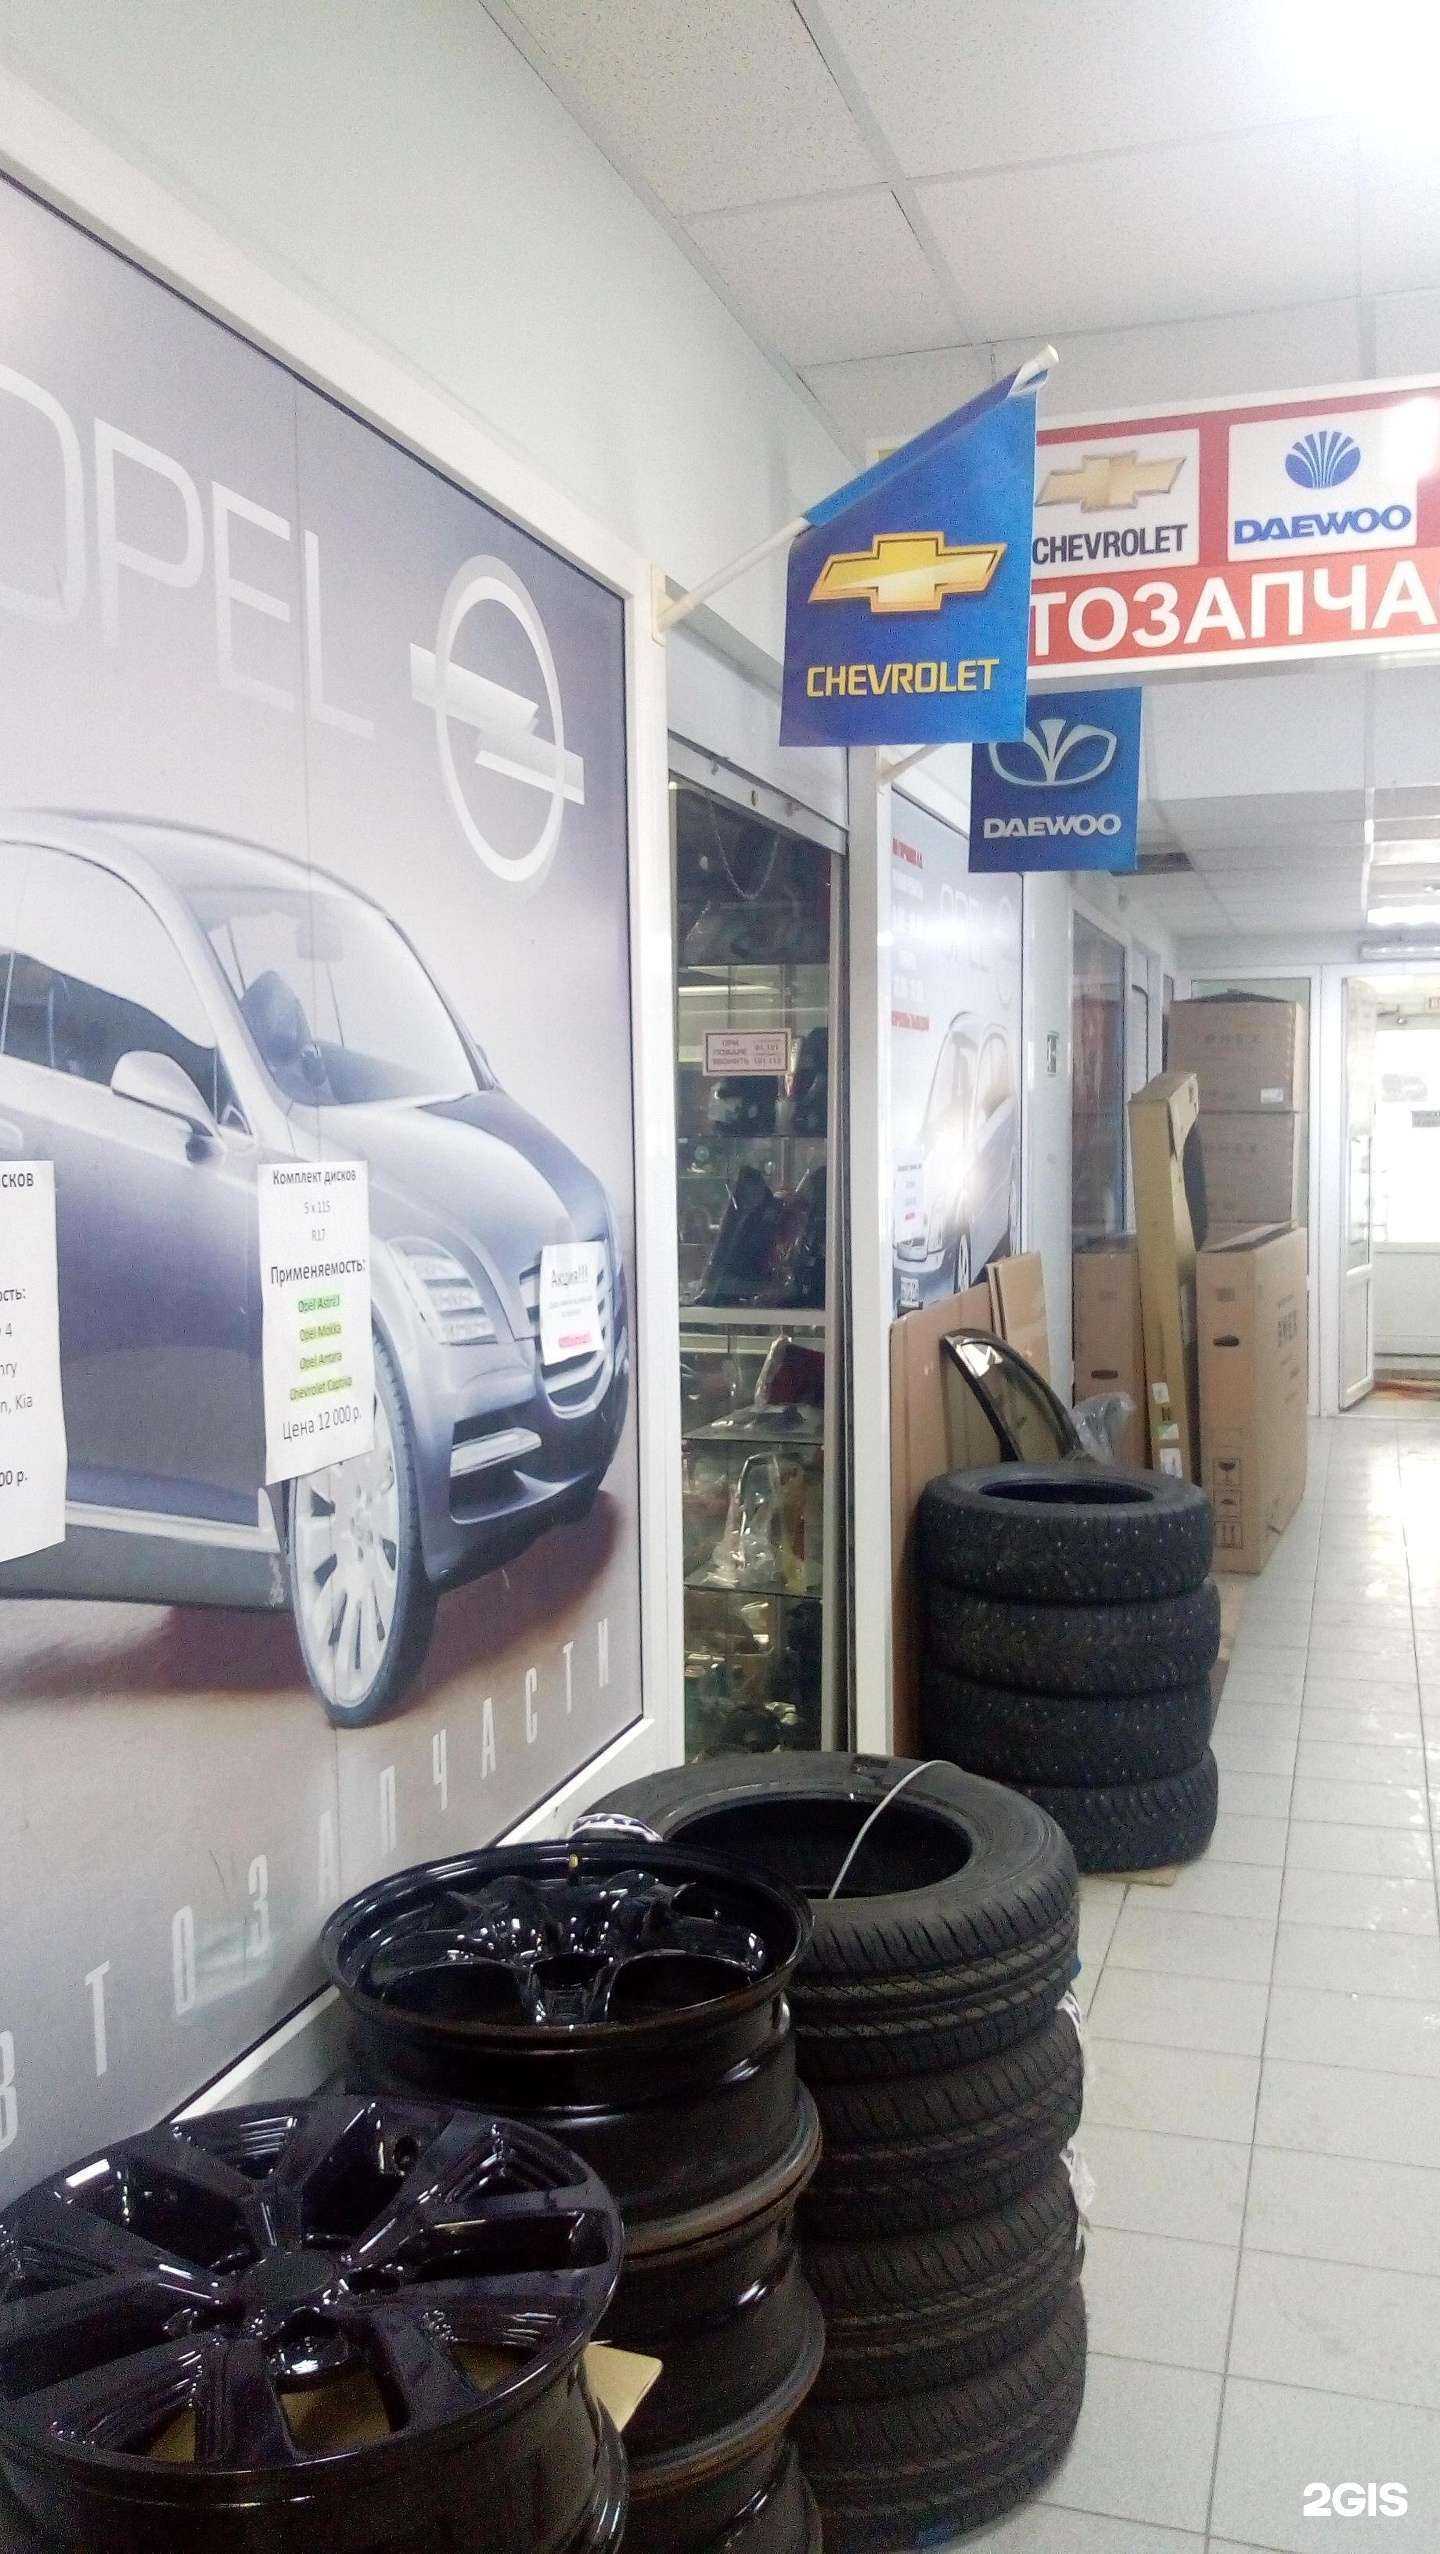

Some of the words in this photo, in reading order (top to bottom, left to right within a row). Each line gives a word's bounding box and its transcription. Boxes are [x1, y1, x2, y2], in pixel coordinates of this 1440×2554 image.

[1233, 504, 1412, 545] DAEWOO
[1032, 523, 1189, 566] CHEVROLET
[1029, 559, 1440, 658] ТОЗАПЧА
[806, 658, 1000, 698] CHEVROLET
[983, 813, 1121, 839] DAEWOO
[272, 1170, 322, 1185] Комплект
[323, 1169, 357, 1186] дисков
[270, 1259, 366, 1288] Применяемость:
[282, 1419, 315, 1442] Цена
